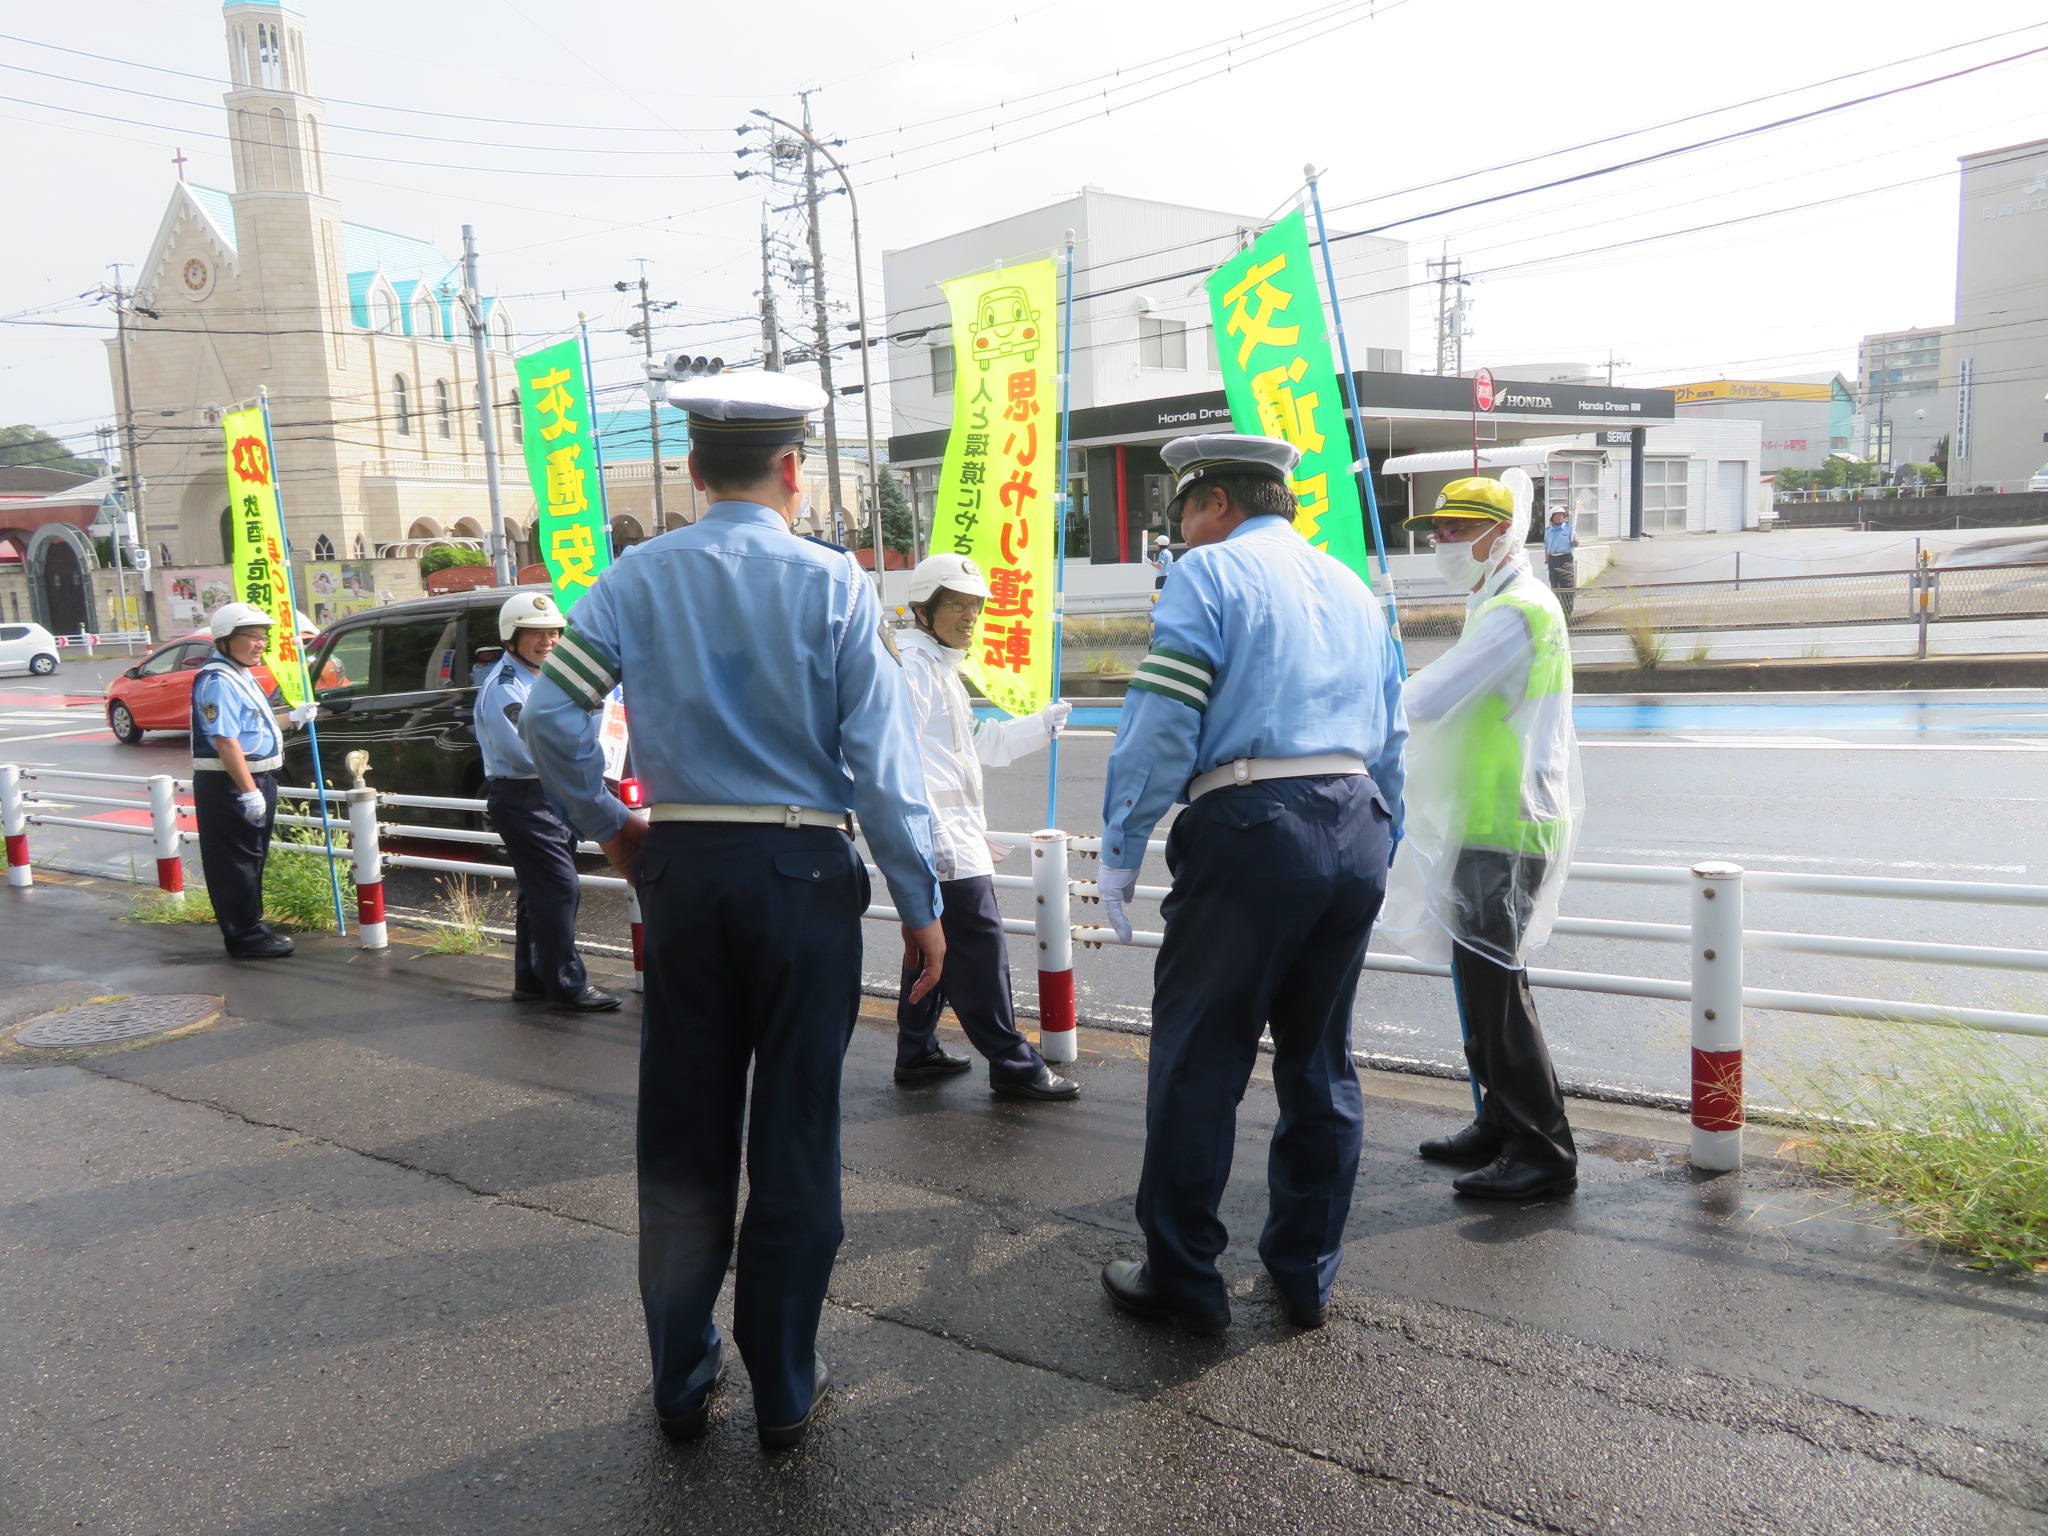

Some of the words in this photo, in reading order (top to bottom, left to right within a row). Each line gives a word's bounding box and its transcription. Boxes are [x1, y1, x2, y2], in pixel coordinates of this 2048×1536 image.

[1506, 395, 1553, 408] HONDA
[1578, 400, 1604, 411] Honda
[1605, 402, 1629, 412] Dream
[1158, 411, 1197, 424] Honda
